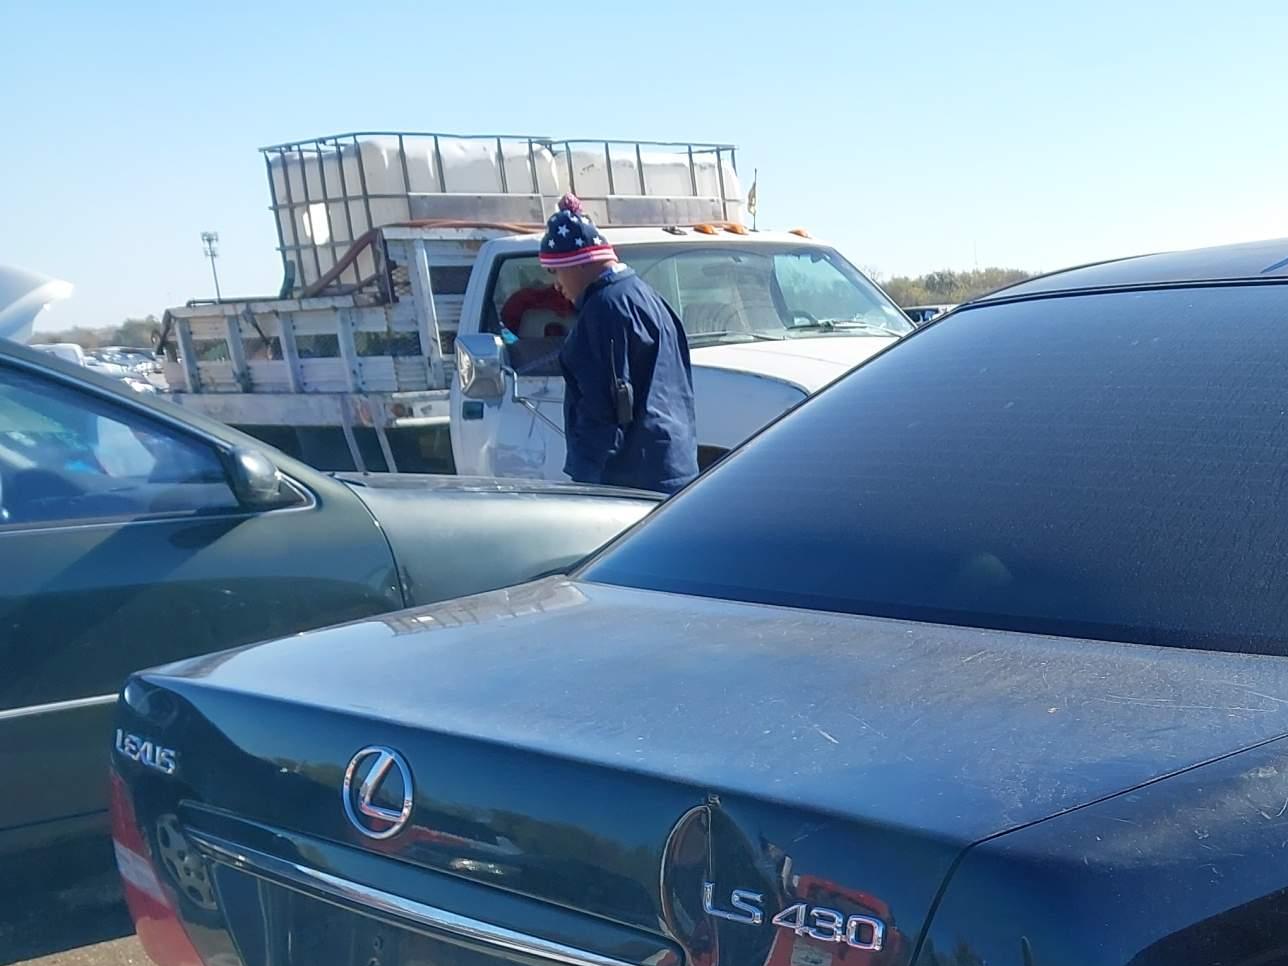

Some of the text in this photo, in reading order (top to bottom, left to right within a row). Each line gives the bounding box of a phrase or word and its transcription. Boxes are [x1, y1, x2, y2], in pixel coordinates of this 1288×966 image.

[116, 728, 176, 775] LEXUS
[703, 880, 885, 952] LS 430
